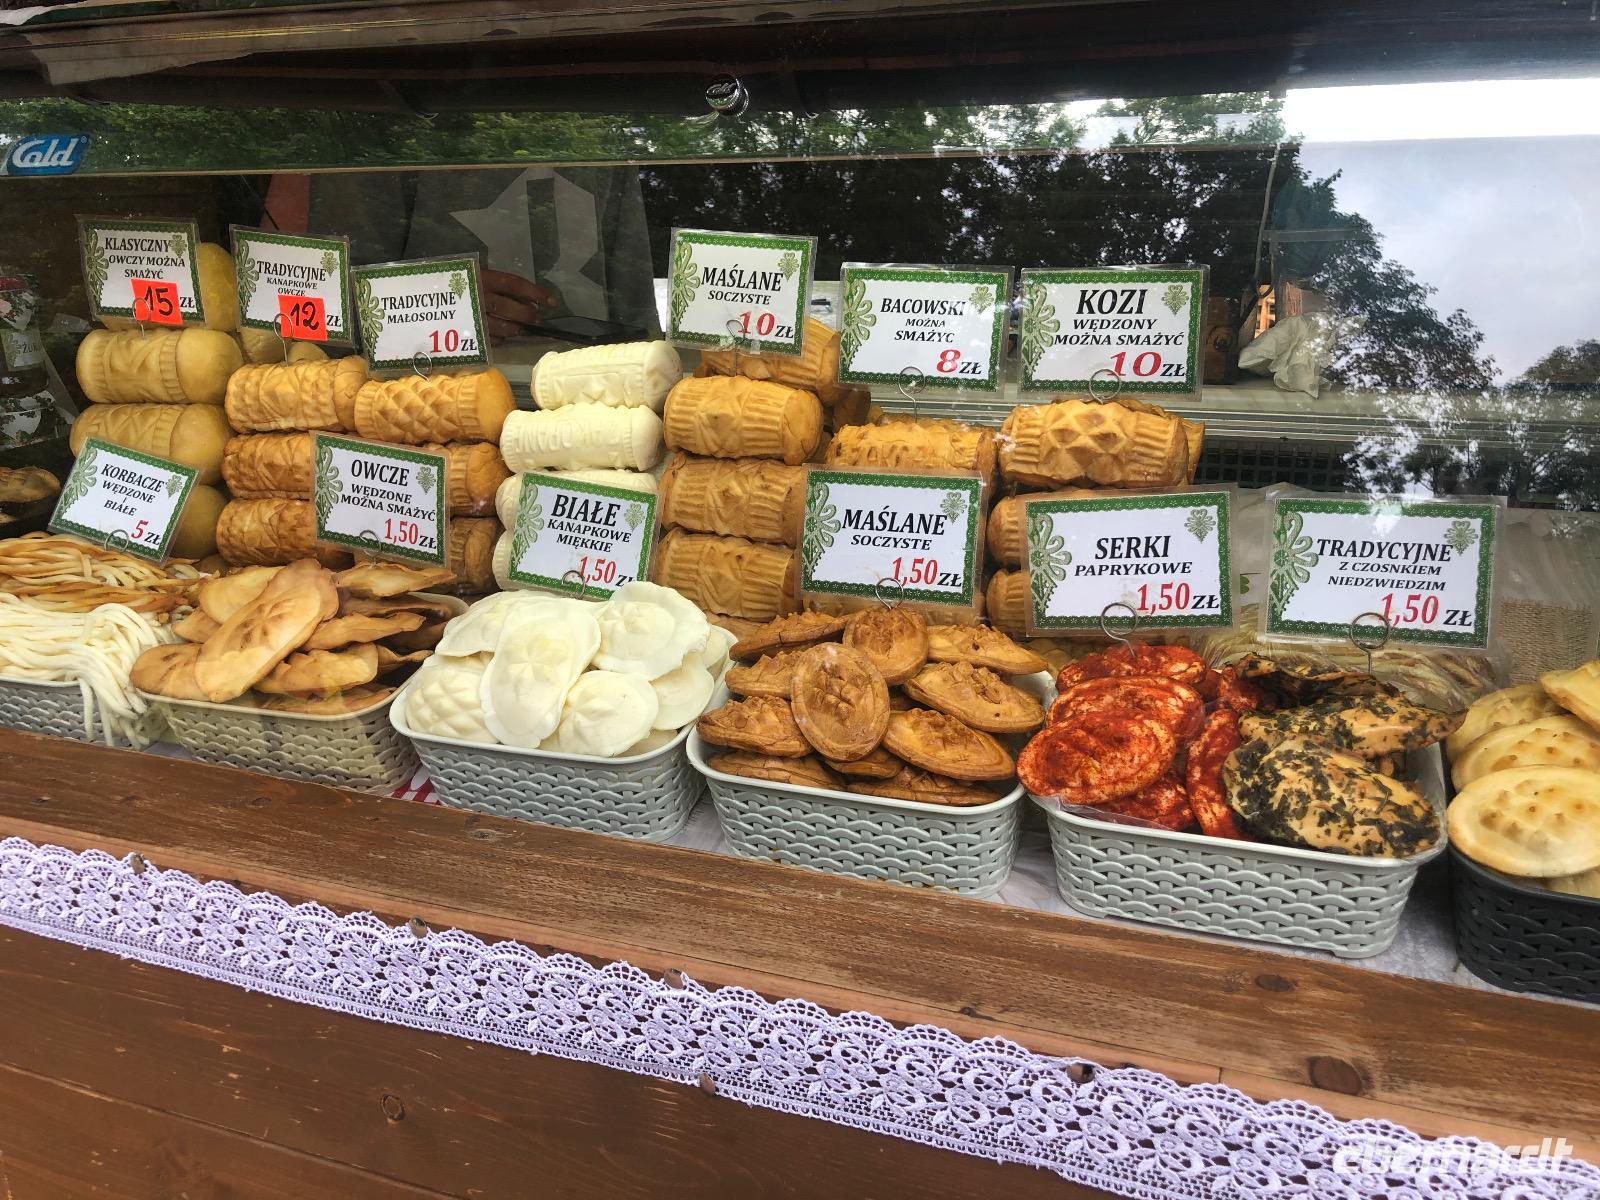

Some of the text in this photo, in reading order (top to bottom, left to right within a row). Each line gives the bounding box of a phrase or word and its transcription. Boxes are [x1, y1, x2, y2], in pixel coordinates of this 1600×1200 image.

[105, 237, 170, 252] KLASYCZNY
[108, 254, 186, 267] OWCZY MOŻNA
[257, 260, 327, 282] TRADYCYJNE
[124, 268, 164, 279] SMAŻYĆ
[266, 277, 318, 289] KANAPKOWE
[701, 263, 784, 292] MAŚLANE
[144, 286, 195, 316] 15 ZŁ
[277, 287, 306, 296] OWCZE
[381, 292, 456, 310] TRADYCYJNE
[708, 290, 771, 305] SOCZYSTE
[1075, 289, 1148, 315] KOZI
[290, 301, 342, 330] 12 ZŁ
[387, 310, 456, 324] MAŁOSOLNY
[880, 297, 967, 316] BACOWSKI
[737, 310, 794, 339] 10 ZŁ
[905, 317, 946, 328] MOŻNA
[1072, 318, 1158, 333] WĘDZONY
[429, 329, 477, 353] 10 ZŁ
[894, 329, 956, 343] SMAŻYC
[1054, 331, 1185, 346] MOŻNA SMAŻYĆ
[936, 349, 983, 375] 8 ZŁ
[1106, 351, 1185, 377] 10 ZŁ
[101, 463, 165, 493] KORBACZE
[351, 459, 410, 487] OWCZE
[102, 480, 156, 504] WĘDZONE
[351, 483, 412, 504] WĘDZONE
[103, 499, 137, 517] BIAŁE
[340, 494, 436, 522] MOŻNA SMAŻYĆ
[551, 493, 621, 527] BIAŁE
[131, 519, 161, 546] 5 ZŁ
[547, 518, 632, 543] KANAPKOWE
[841, 505, 948, 536] MAŚLANE
[384, 518, 437, 549] 1,50 ZŁ
[556, 533, 614, 553] MIĘKKIE
[850, 534, 933, 551] SOCZYSTE
[1094, 535, 1172, 560] SERKI
[1316, 538, 1454, 564] TRADYCYJNE
[578, 556, 617, 584] 1,50
[892, 556, 962, 588] 1,50 ZŁ
[1074, 561, 1193, 577] PAPRYKOWE
[1338, 561, 1443, 576] Z CZOSNKIEM
[1327, 575, 1447, 592] NIEDZWIEDZIM
[1136, 582, 1220, 615] 1,50 ZŁ
[1379, 592, 1473, 628] 1,50 ZŁ
